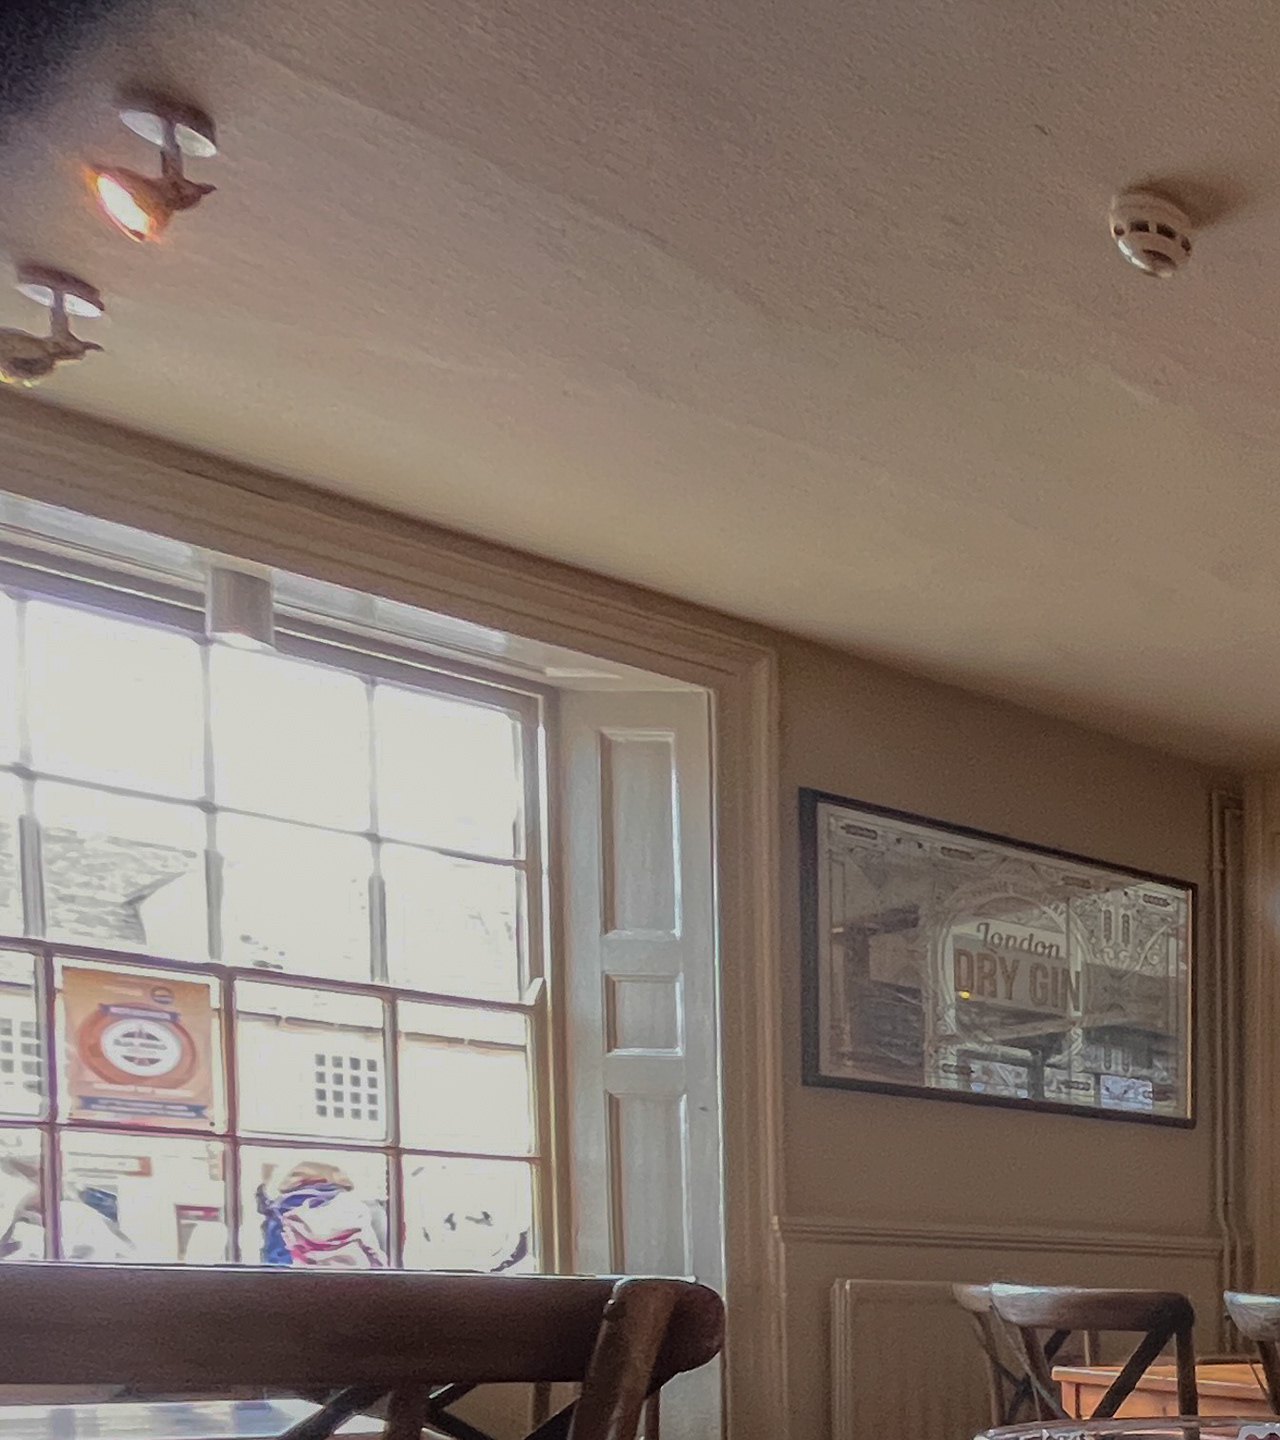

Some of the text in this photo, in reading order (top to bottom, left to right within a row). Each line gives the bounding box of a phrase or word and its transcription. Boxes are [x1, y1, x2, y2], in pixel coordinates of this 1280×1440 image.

[977, 922, 1060, 960] London
[955, 948, 1080, 1012] DRY GIN
